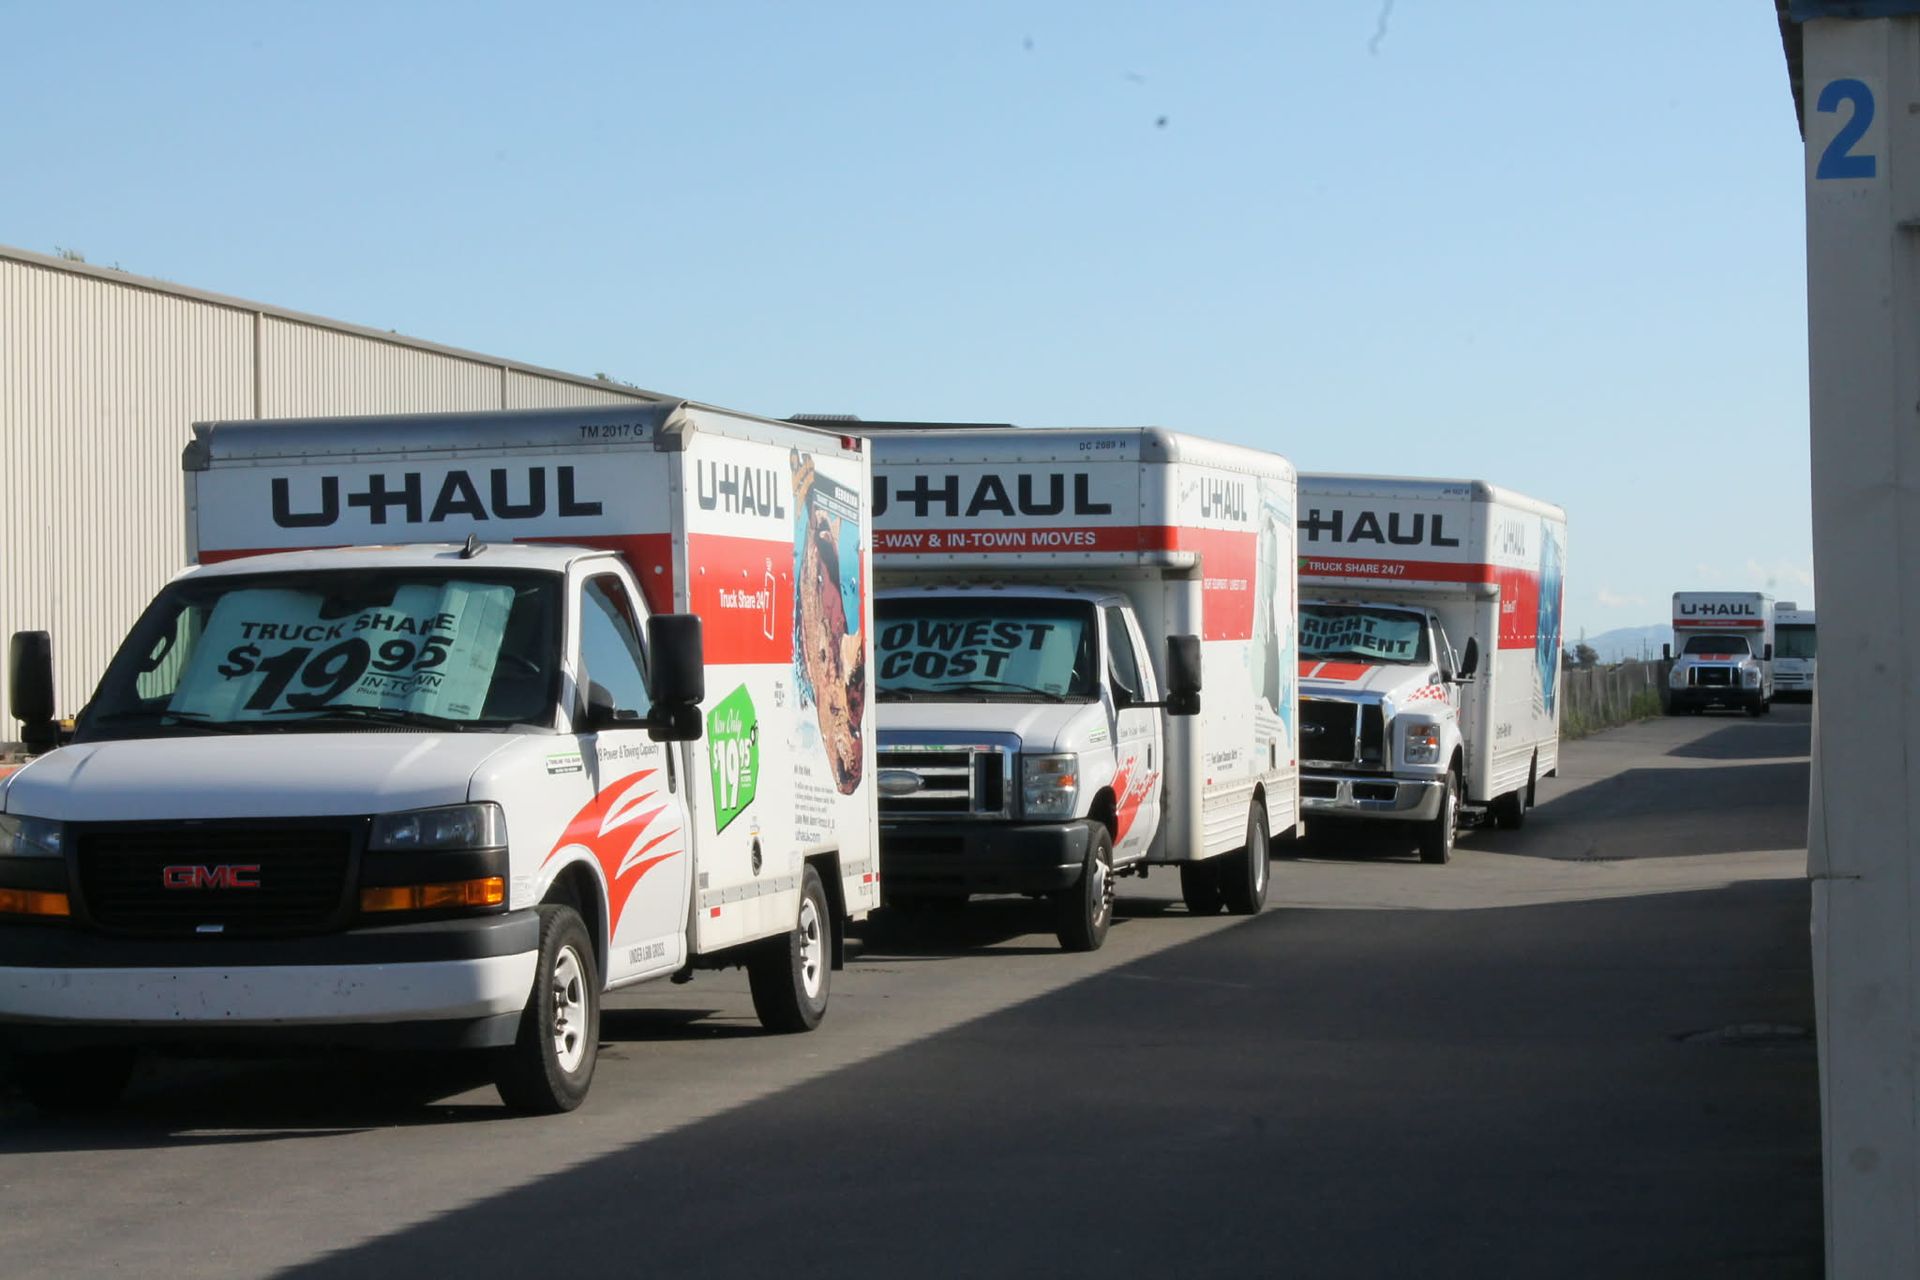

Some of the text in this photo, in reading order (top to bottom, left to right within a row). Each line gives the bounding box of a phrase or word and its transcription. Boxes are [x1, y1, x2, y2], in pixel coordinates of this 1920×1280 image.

[1816, 78, 1876, 180] 2
[579, 423, 644, 438] TM 2017 G
[271, 465, 603, 528] U-HAUL
[697, 459, 785, 520] U-HAUL
[872, 472, 1112, 518] -HAUL
[1201, 476, 1247, 522] U-HAUL
[928, 534, 941, 548] &
[947, 532, 1026, 547] IN-TOWN
[1031, 531, 1096, 546] MOVES
[1309, 561, 1405, 575] TRUCK SHARE 24/7
[719, 588, 737, 608] Truck
[738, 589, 755, 608] Share
[1680, 603, 1755, 615] U-HAUL
[241, 622, 346, 641] TRUCK
[874, 620, 1055, 651] OWEST
[1303, 616, 1377, 636] RIGHT
[880, 649, 1010, 680] COST
[603, 748, 618, 761] Power
[623, 744, 640, 759] Towing
[640, 742, 659, 757] Capacity
[163, 864, 261, 889] GMC
